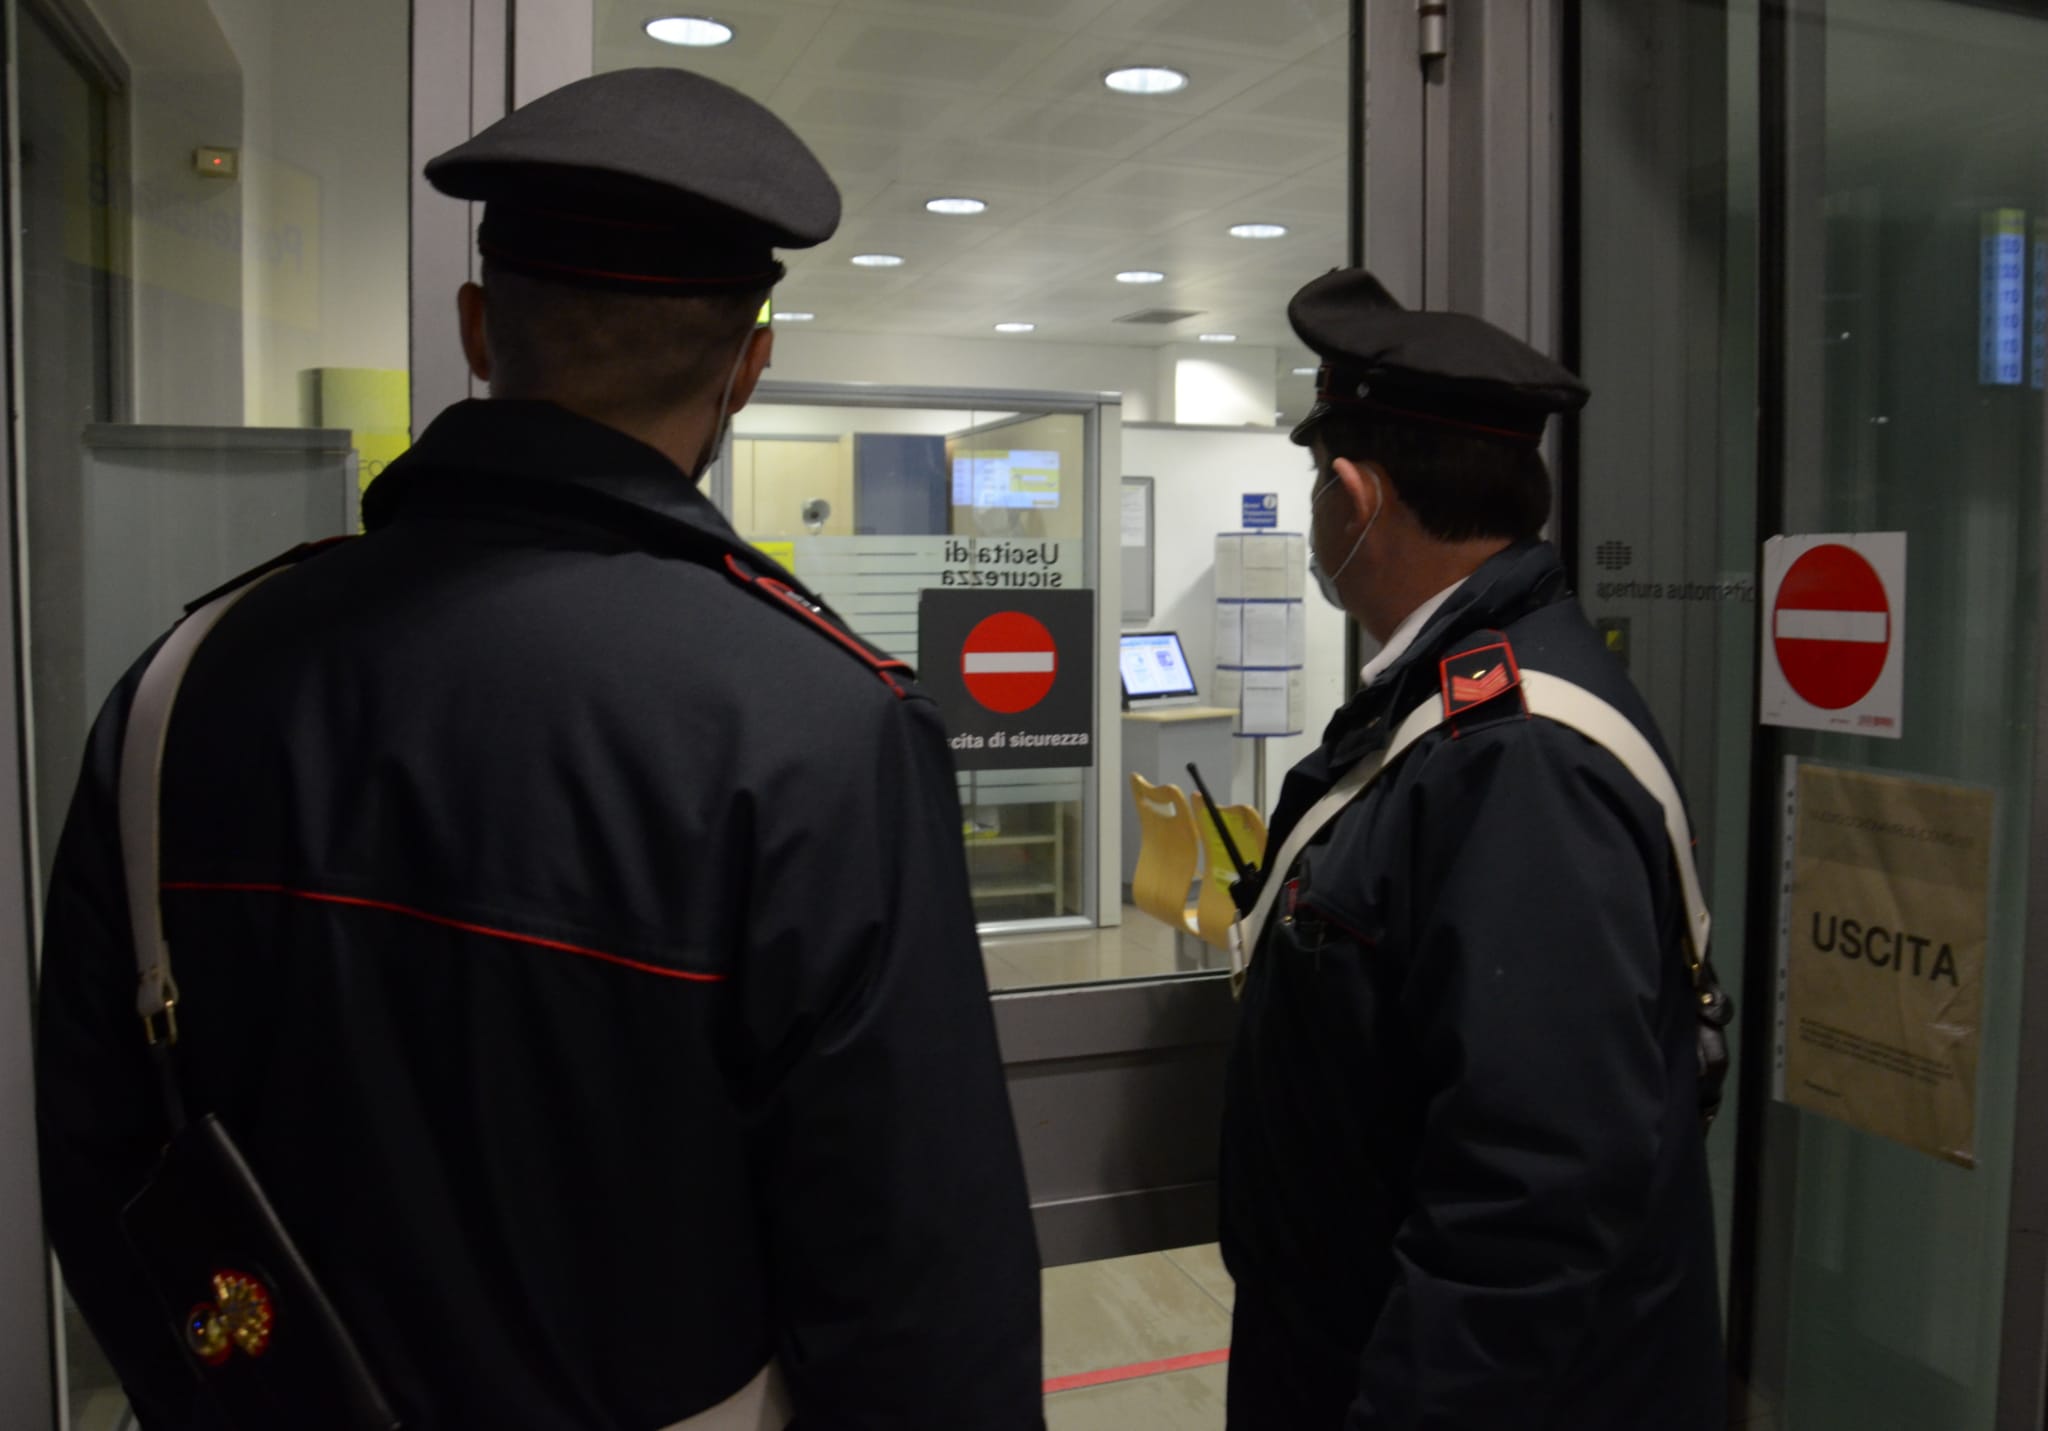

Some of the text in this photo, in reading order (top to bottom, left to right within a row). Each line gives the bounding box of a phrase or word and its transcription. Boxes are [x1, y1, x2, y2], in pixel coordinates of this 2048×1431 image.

[1596, 580, 1756, 602] apertura automatic
[946, 730, 1089, 749] cita di sicurezza
[1812, 911, 1959, 986] USCITA
